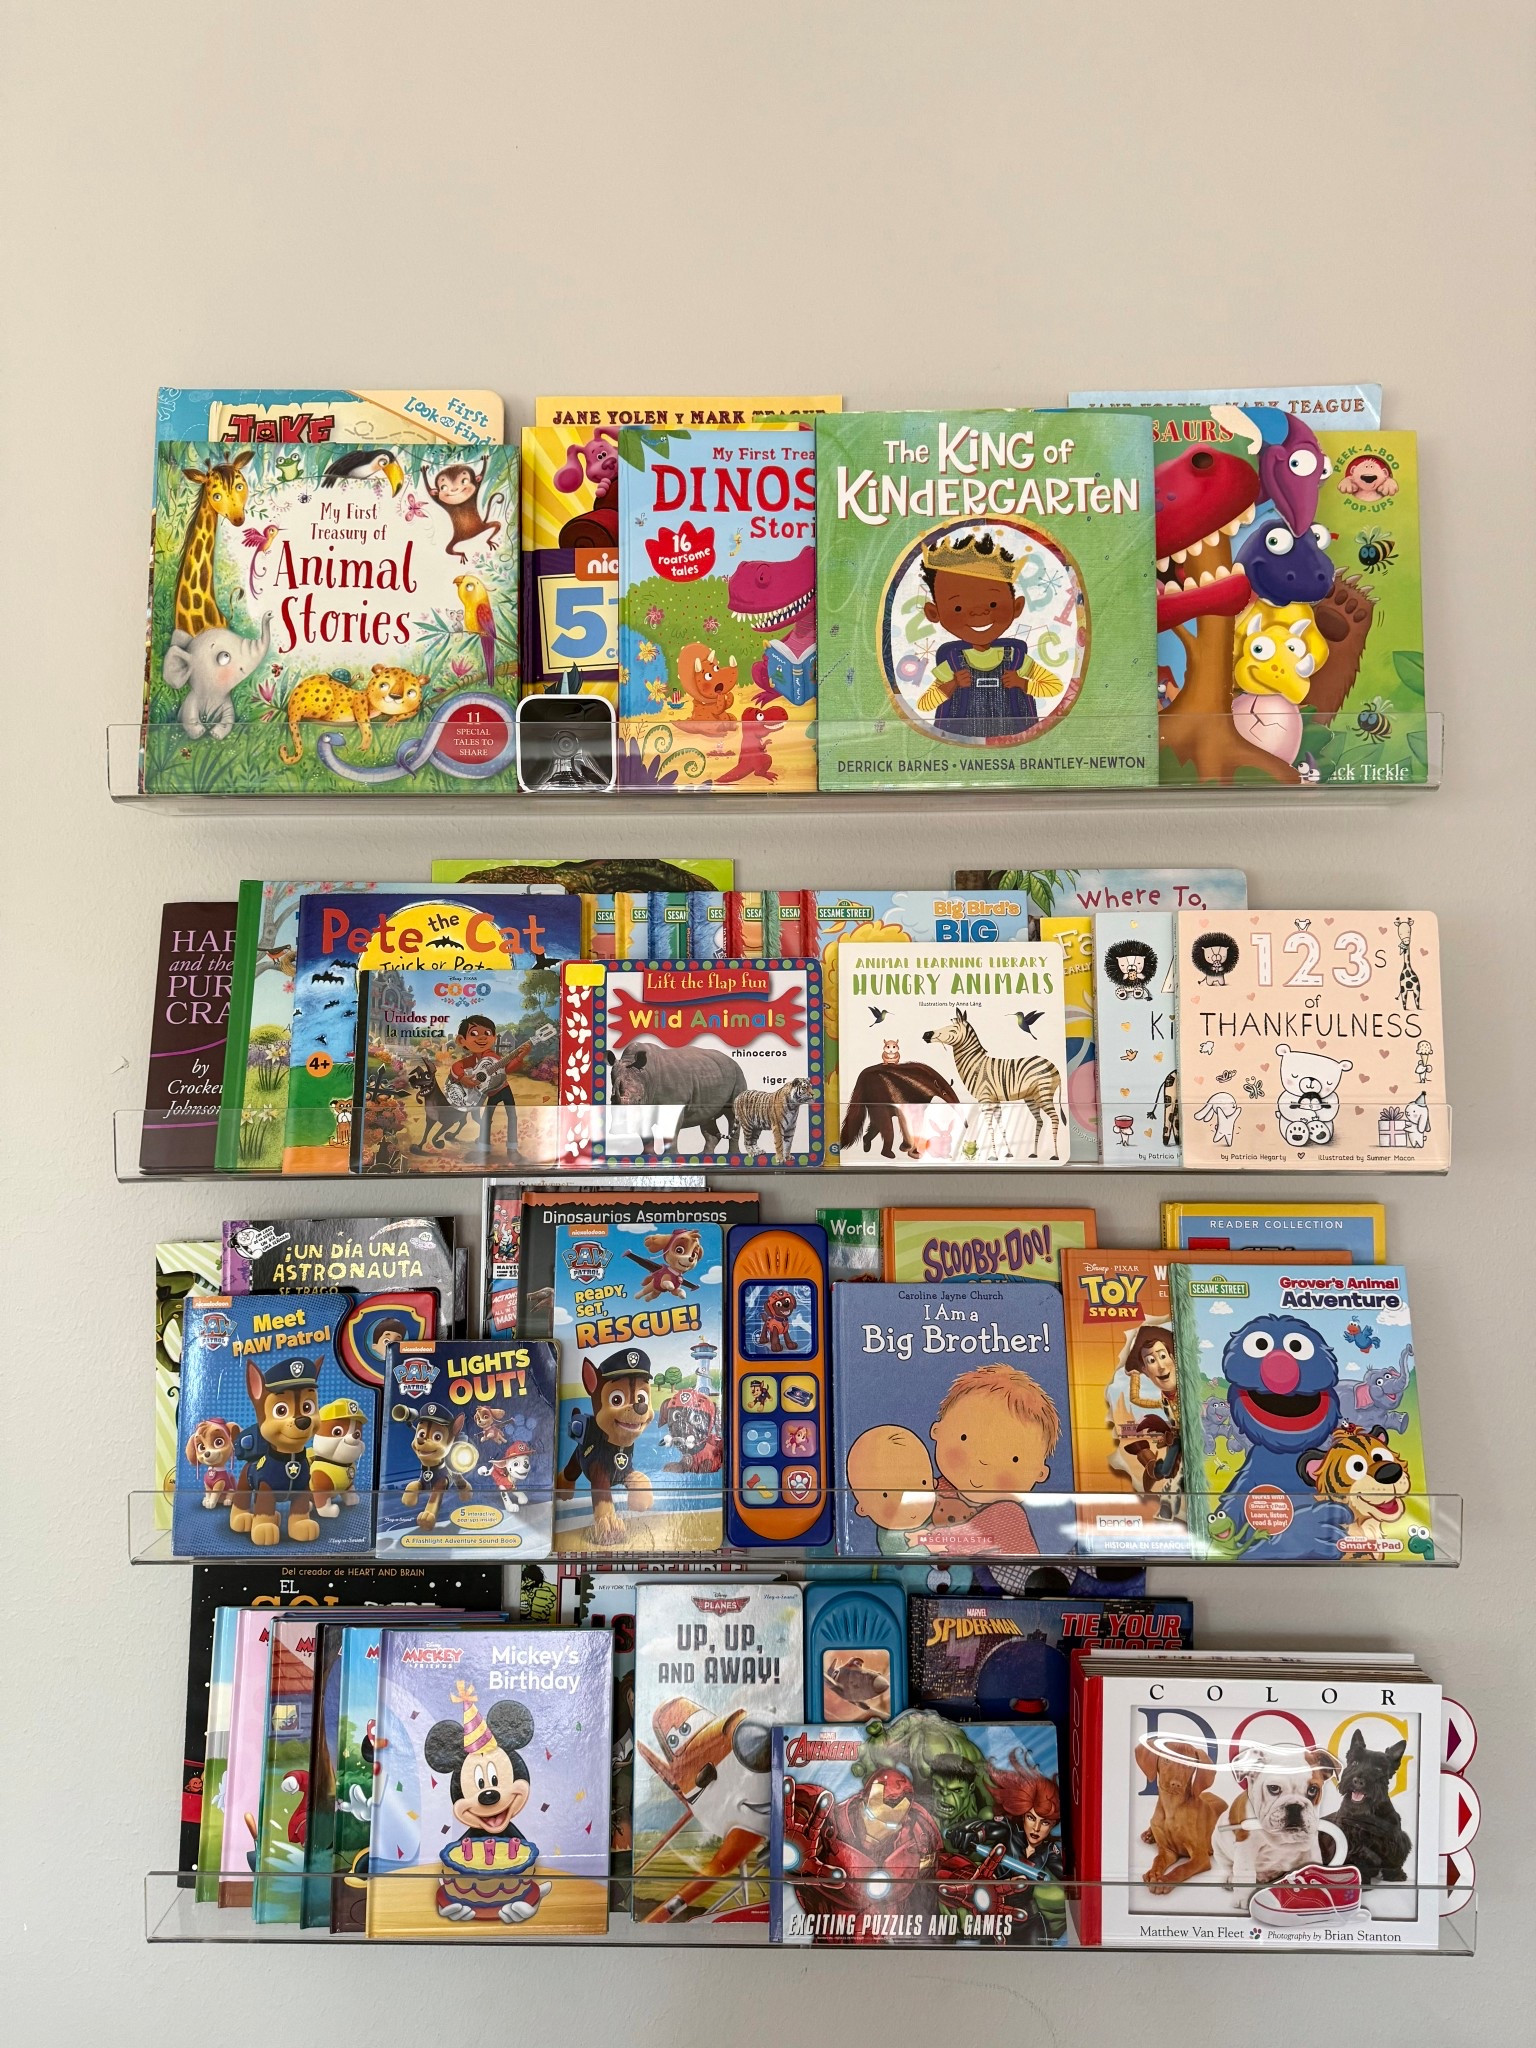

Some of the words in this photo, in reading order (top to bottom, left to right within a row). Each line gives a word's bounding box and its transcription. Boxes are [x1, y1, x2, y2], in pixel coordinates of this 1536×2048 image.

[404, 396, 440, 424] Look
[447, 398, 489, 428] First
[1288, 398, 1365, 414] TEAGUE
[553, 411, 601, 425] JANE
[607, 411, 668, 425] YOLEN
[690, 411, 745, 425] MARK
[713, 447, 733, 462] My
[738, 447, 776, 460] First
[883, 440, 930, 464] The
[1043, 438, 1076, 464] of
[1333, 444, 1399, 473] PEEK-A-BOO
[320, 502, 340, 521] My
[346, 502, 378, 520] First
[1344, 498, 1394, 513] POP-UPS
[311, 523, 367, 544] Treasury
[373, 525, 388, 540] of
[672, 534, 691, 552] 16
[659, 547, 711, 565] roarsome
[273, 540, 417, 593] Animal
[671, 564, 699, 577] tales
[278, 592, 411, 654] Stories
[467, 712, 481, 724] 11
[456, 727, 491, 737] SPECIAL
[453, 738, 478, 747] TALES
[480, 738, 494, 747] TO
[459, 748, 488, 757] SHARE
[837, 759, 893, 774] DERRICK
[898, 758, 949, 773] BARNES
[959, 757, 1014, 772] VANESSA
[1020, 756, 1146, 770] BRANTLEY-NEWTON
[1360, 764, 1409, 777] Tickle
[1077, 888, 1161, 909] Where
[1172, 886, 1207, 910] To,
[819, 908, 845, 918] SESAME
[846, 908, 870, 918] STREET
[933, 901, 963, 918] Big
[967, 900, 1022, 916] Bird's
[321, 908, 424, 953] Pete
[428, 913, 460, 933] the
[465, 912, 546, 955] Cat
[935, 919, 999, 943] BIG
[168, 951, 203, 972] and
[208, 953, 234, 972] the
[855, 957, 910, 969] ANIMAL
[916, 957, 983, 969] LEARNING
[989, 956, 1048, 968] LIBRARY
[434, 983, 491, 998] COCO
[647, 972, 677, 990] Lift
[681, 971, 704, 989] the
[707, 971, 736, 993] flap
[741, 972, 767, 989] fun
[852, 973, 940, 996] HUNGRY
[950, 972, 1054, 996] ANIMALS
[1305, 994, 1322, 1009] of
[384, 1009, 428, 1024] Unidos
[430, 1014, 450, 1027] por
[629, 1008, 682, 1028] Wild
[690, 1008, 786, 1028] Animals
[1200, 1012, 1422, 1038] THANKFULNESS
[386, 1025, 397, 1038] la
[400, 1026, 445, 1038] música
[731, 1048, 787, 1058] rhinoceros
[191, 1058, 210, 1077] by
[309, 1058, 330, 1071] 4+
[763, 1074, 787, 1086] tiger
[1148, 1152, 1174, 1160] Patricia
[1230, 1153, 1257, 1161] Patricia
[1259, 1153, 1287, 1162] Hegarty
[1366, 1154, 1391, 1162] Summer
[543, 1210, 631, 1223] Dinosaurios
[636, 1210, 727, 1223] Asombrosos
[1209, 1219, 1259, 1229] READER
[1264, 1219, 1344, 1229] COLLECTION
[829, 1218, 876, 1236] World
[285, 1244, 323, 1262] ¡UN
[331, 1238, 363, 1259] DÍA
[369, 1241, 410, 1257] UNA
[562, 1247, 614, 1269] PAW
[272, 1260, 423, 1283] ASTRONAUTA
[1192, 1283, 1218, 1295] SESAME
[1219, 1283, 1246, 1295] STREET
[1280, 1276, 1346, 1291] Grover's
[1347, 1276, 1400, 1291] Animal
[898, 1290, 938, 1301] Caroline
[940, 1290, 967, 1302] Jayne
[970, 1290, 1004, 1301] Church
[1280, 1291, 1401, 1309] Adventure
[924, 1304, 931, 1321] I
[935, 1303, 965, 1321] Am
[970, 1310, 979, 1322] a
[1089, 1307, 1139, 1317] STORY
[252, 1309, 306, 1334] Meet
[575, 1304, 702, 1350] RESCUE!
[232, 1335, 272, 1358] PAW
[275, 1325, 332, 1352] Patrol
[862, 1323, 914, 1360] Big
[922, 1322, 1051, 1354] Brother!
[447, 1348, 531, 1379] LIGHTS
[393, 1363, 441, 1384] PAW
[448, 1369, 528, 1405] OUT!
[1099, 1516, 1141, 1528] bendon
[1250, 1511, 1269, 1520] Learn,
[412, 1537, 443, 1546] Flashlight
[1104, 1541, 1137, 1549] HISTORIA
[1139, 1541, 1149, 1549] EN
[1339, 1541, 1372, 1550] Smart
[281, 1568, 296, 1576] Del
[299, 1568, 332, 1576] creador
[334, 1568, 345, 1576] de
[347, 1568, 375, 1577] HEART
[377, 1568, 397, 1577] AND
[400, 1568, 425, 1577] BRAIN
[280, 1580, 299, 1593] EL
[966, 1607, 987, 1617] MARVEL
[926, 1617, 1024, 1647] SPIDER-MAN
[1061, 1613, 1100, 1637] TIE
[1108, 1613, 1181, 1638] YOUR
[677, 1624, 716, 1655] UP,
[724, 1624, 763, 1655] UP,
[401, 1647, 464, 1663] MICKEY
[490, 1645, 580, 1667] Mickey's
[658, 1662, 696, 1684] AND
[704, 1656, 781, 1685] AWAY!
[488, 1671, 580, 1693] Birthday
[1149, 1684, 1396, 1706] COLOR
[787, 1913, 855, 1937] EXCITING
[863, 1914, 922, 1937] PUZZLES
[928, 1914, 959, 1936] AND
[964, 1913, 1013, 1936] GAMES
[1139, 1925, 1189, 1937] Matthew
[1192, 1926, 1214, 1938] Van
[1217, 1926, 1244, 1938] Fleet
[1267, 1930, 1311, 1942] Photography
[1313, 1931, 1322, 1942] by
[1324, 1930, 1354, 1941] Brian
[1357, 1930, 1402, 1942] Stanton
